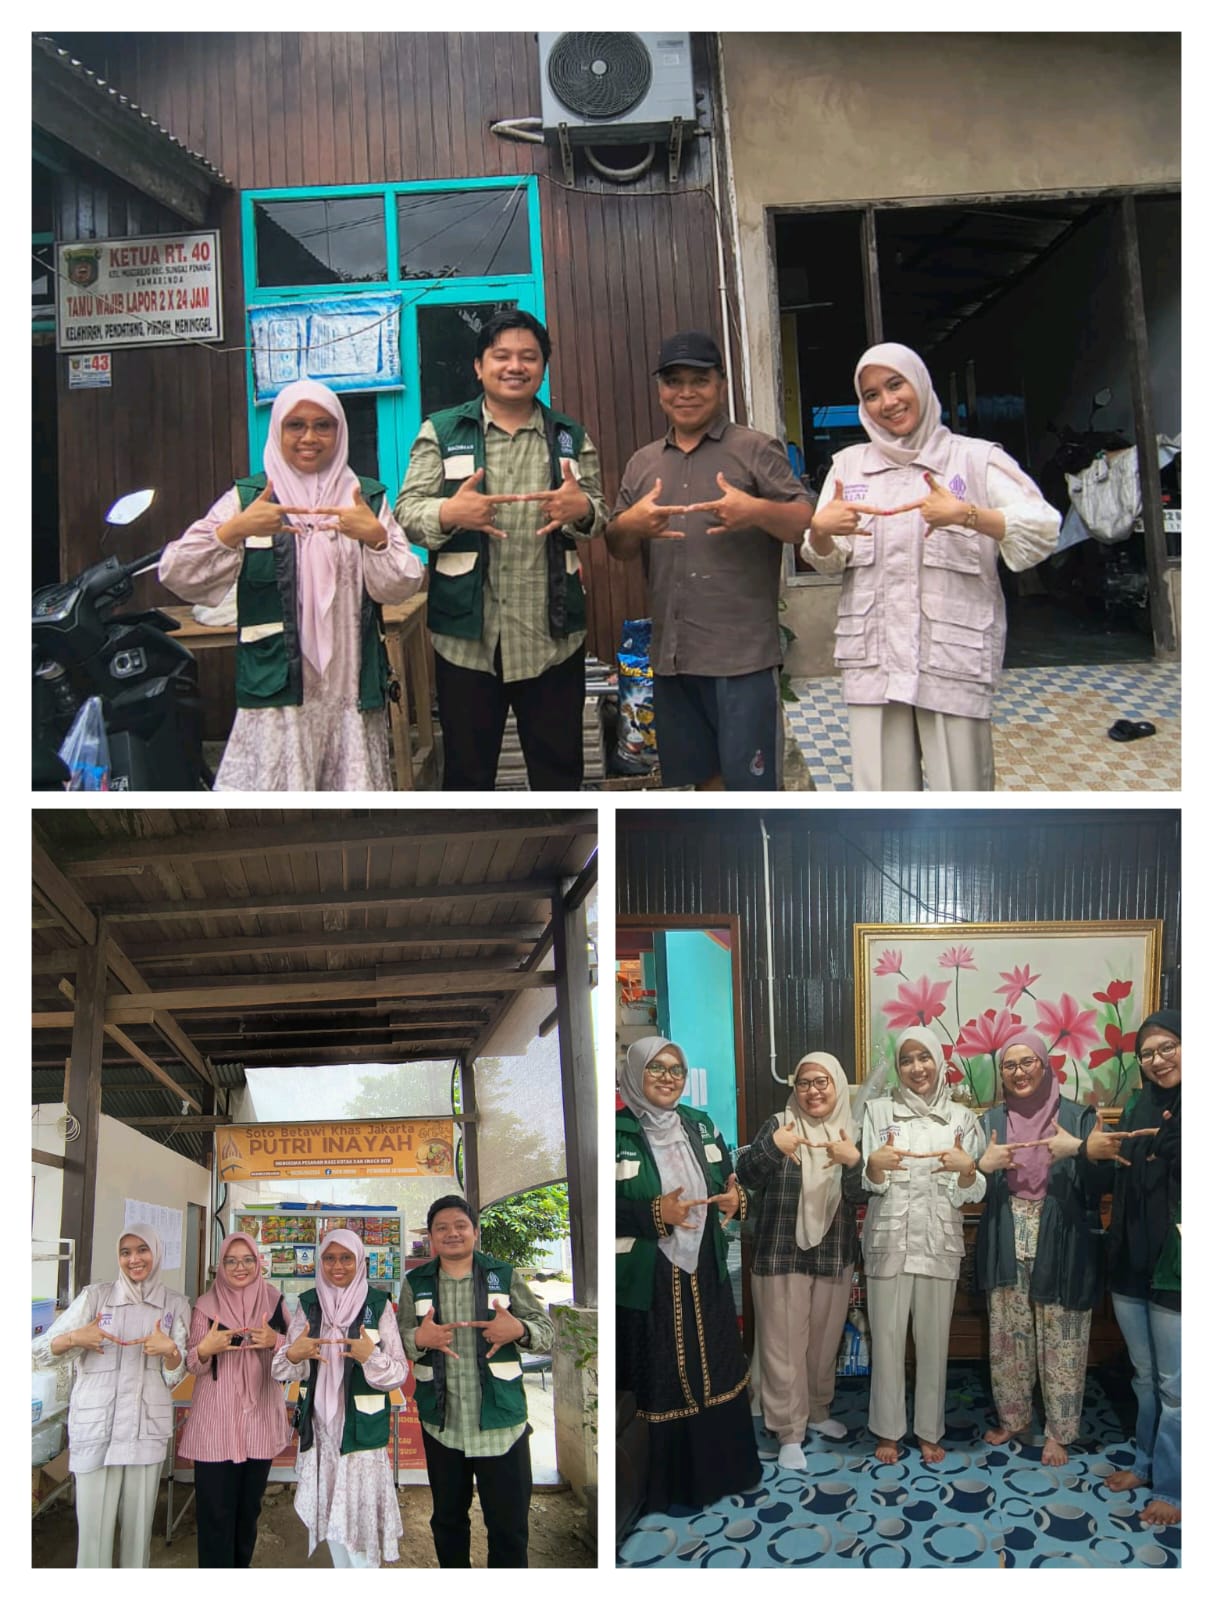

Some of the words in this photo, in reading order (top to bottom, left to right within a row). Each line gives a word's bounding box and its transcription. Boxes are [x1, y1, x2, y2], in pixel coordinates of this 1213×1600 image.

[109, 247, 160, 268] KETUA
[165, 243, 187, 264] RT.
[192, 241, 210, 262] 40
[165, 265, 188, 274] SUNGAI
[189, 263, 211, 272] PINANG
[136, 276, 184, 287] SAMARINDA
[67, 296, 93, 317] TAMU
[96, 293, 125, 316] WAJIB
[126, 290, 157, 313] LAPOR
[159, 290, 166, 311] 2
[168, 289, 174, 310] X
[177, 288, 188, 309] 24
[190, 286, 209, 309] JAM
[175, 317, 212, 334] MENINGGAL
[91, 355, 109, 371] 43
[246, 1128, 275, 1138] Soto
[281, 1126, 325, 1137] Betawi
[331, 1125, 360, 1136] Khas
[368, 1124, 415, 1135] Jakarta
[249, 1137, 312, 1155] PUTRI
[322, 1134, 413, 1153] INAYAH
